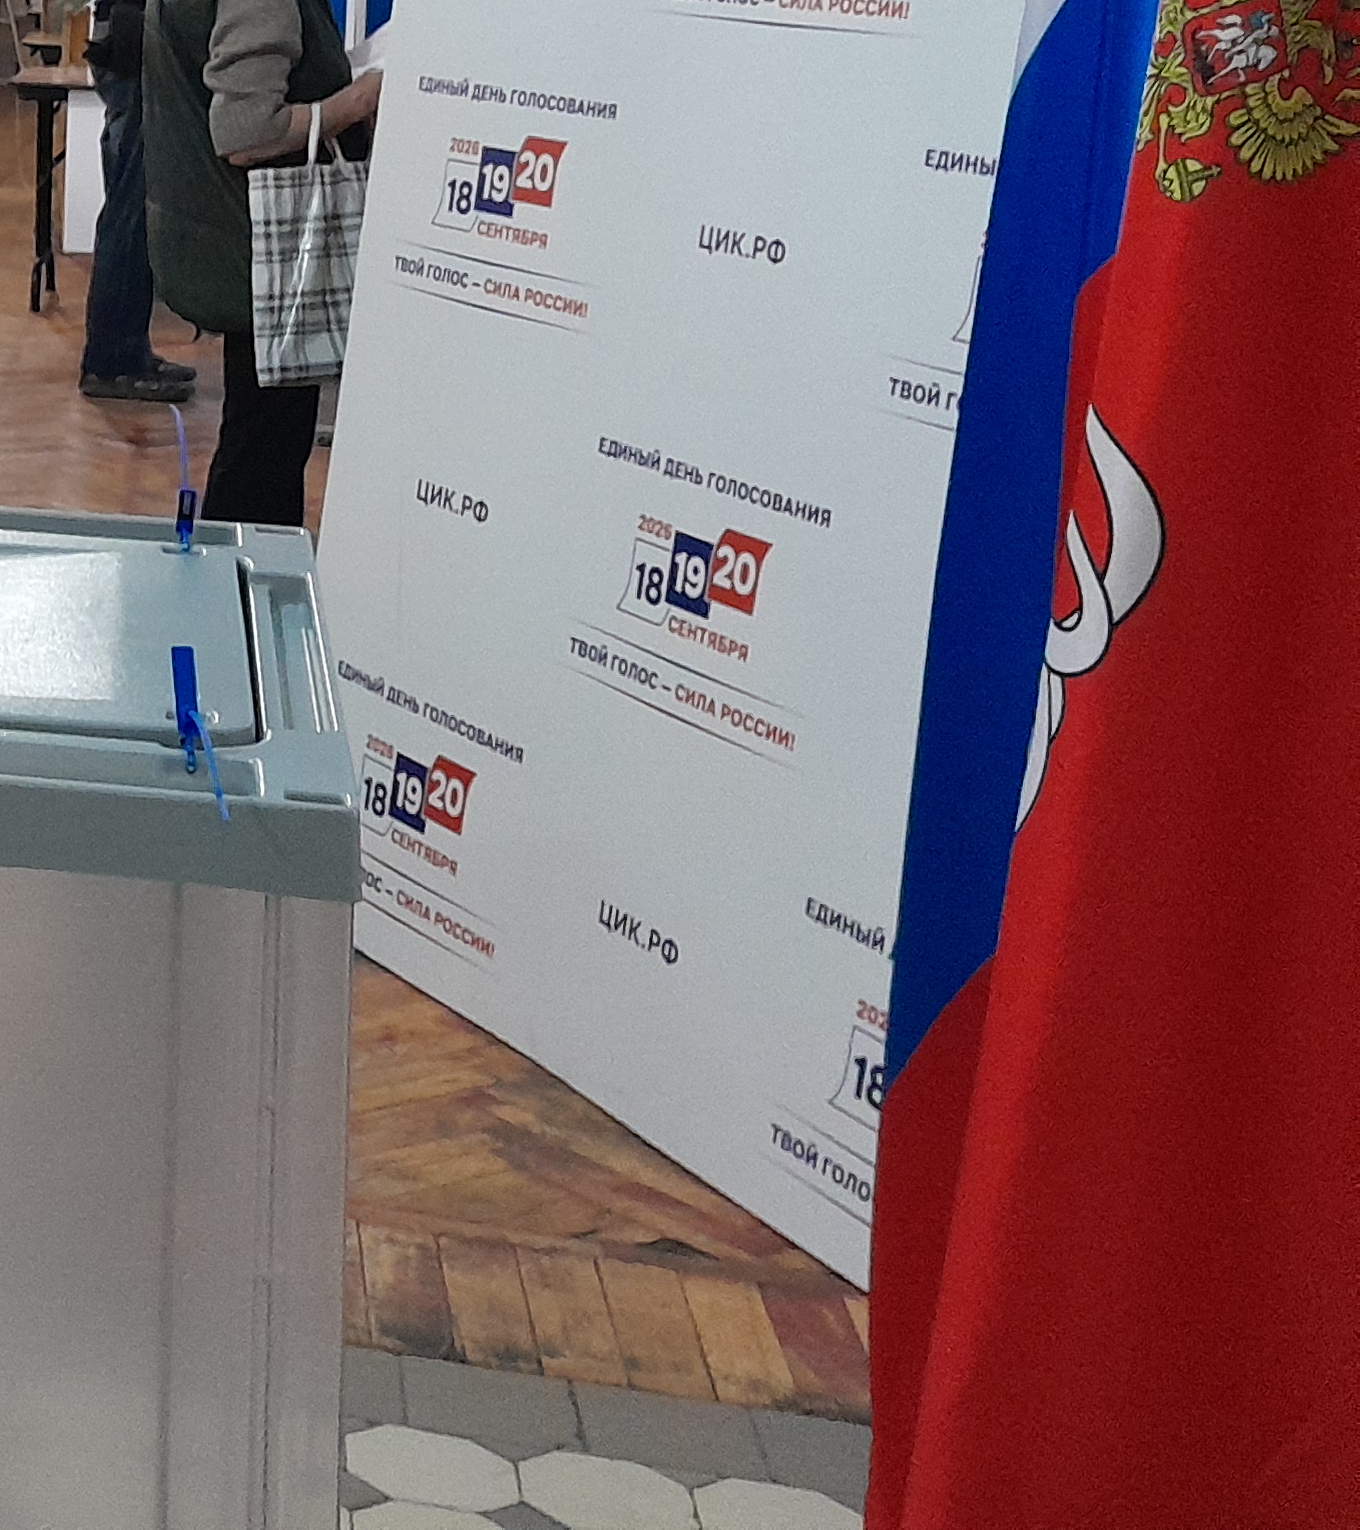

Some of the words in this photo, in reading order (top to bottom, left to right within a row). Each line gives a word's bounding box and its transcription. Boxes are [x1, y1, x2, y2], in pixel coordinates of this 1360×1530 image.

[471, 84, 507, 105] ДЕНЬ
[510, 89, 618, 119] ГОЛОСОВАНИЯ
[447, 178, 473, 215] 18
[481, 163, 509, 203] 19
[515, 150, 554, 192] 20
[925, 149, 997, 177] ЕДИНЫ
[477, 220, 548, 249] СЕНТЯБРЯ
[698, 224, 786, 264] ЦИК.РФ
[395, 255, 425, 277] ТВОЙ
[427, 263, 468, 289] ГОЛОС
[483, 278, 520, 301] СИЛА
[524, 288, 589, 318] РОССИИ!
[889, 376, 941, 408] ТВОЙ
[417, 478, 489, 523] ЦИК.РФ
[598, 436, 660, 471] ЕДИНЫЙ
[663, 457, 704, 485] ДЕНЬ
[707, 473, 832, 529] ГОЛОСОВАНИЯ
[635, 562, 664, 606] 18
[673, 552, 706, 600] 19
[712, 544, 758, 596] 20
[668, 615, 749, 663] СЕНТЯБРЯ
[570, 636, 608, 665] ТВОЙ
[611, 655, 659, 689] ГОЛОС
[674, 684, 716, 717] СИЛА
[721, 702, 796, 752] РОССИИ!
[386, 686, 420, 714] ДЕНЬ
[423, 702, 524, 764] ГОЛОСОВАНИЯ
[363, 776, 387, 818] 18
[396, 772, 423, 815] 19
[428, 769, 465, 817] 20
[397, 890, 431, 921] СИЛА
[434, 911, 495, 958] РОССИИ!
[598, 899, 679, 965] ЦИК.РФ
[805, 896, 885, 954] ЕДИНЫЙ
[856, 999, 889, 1031] 202
[771, 1123, 818, 1170] ТВОЙ
[821, 1155, 871, 1202] ГОЛО
